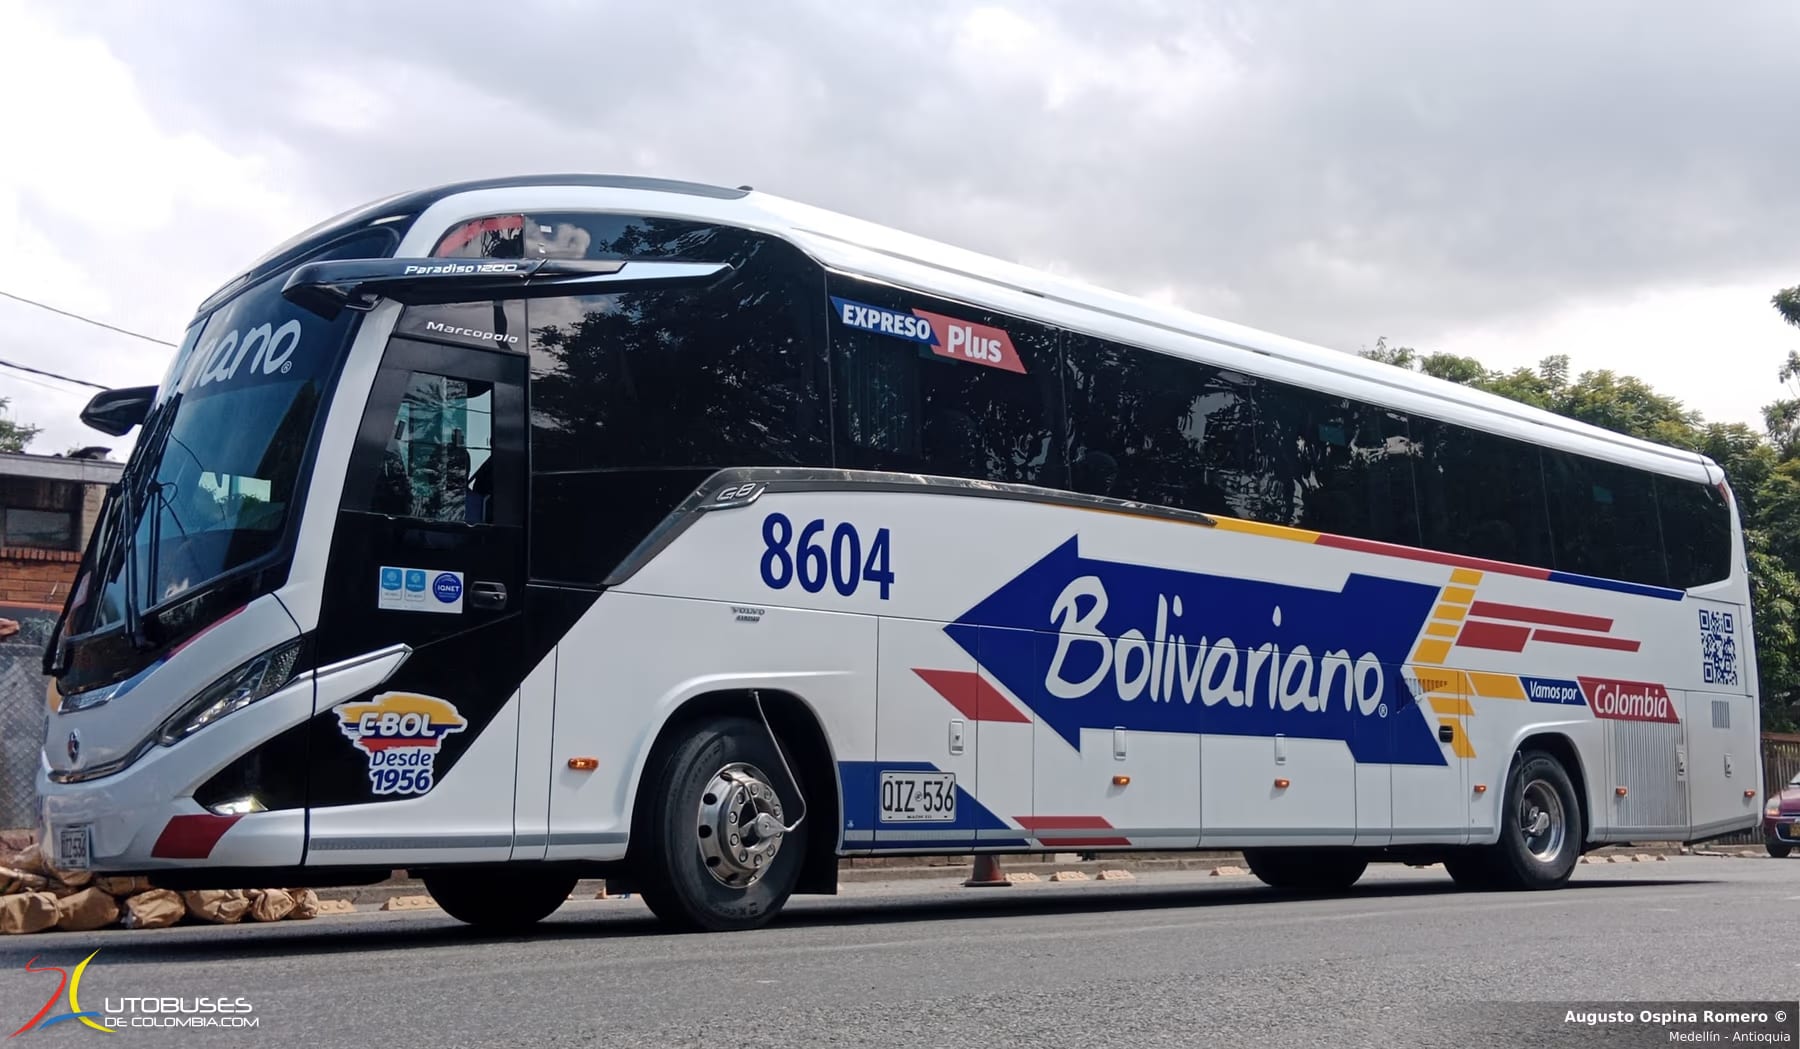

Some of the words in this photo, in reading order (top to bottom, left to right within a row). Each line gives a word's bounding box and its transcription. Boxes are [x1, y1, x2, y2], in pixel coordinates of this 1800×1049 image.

[404, 263, 474, 275] Paradiso
[477, 263, 518, 273] 1200
[426, 321, 518, 344] Marcopolo
[842, 303, 931, 340] EXPRESO
[947, 324, 1002, 363] Plus
[760, 512, 894, 600] 8604
[1529, 681, 1561, 700] Vamos
[1561, 687, 1577, 703] por
[1594, 684, 1668, 719] Colombia
[372, 749, 431, 767] Desde
[372, 769, 431, 792] 1956
